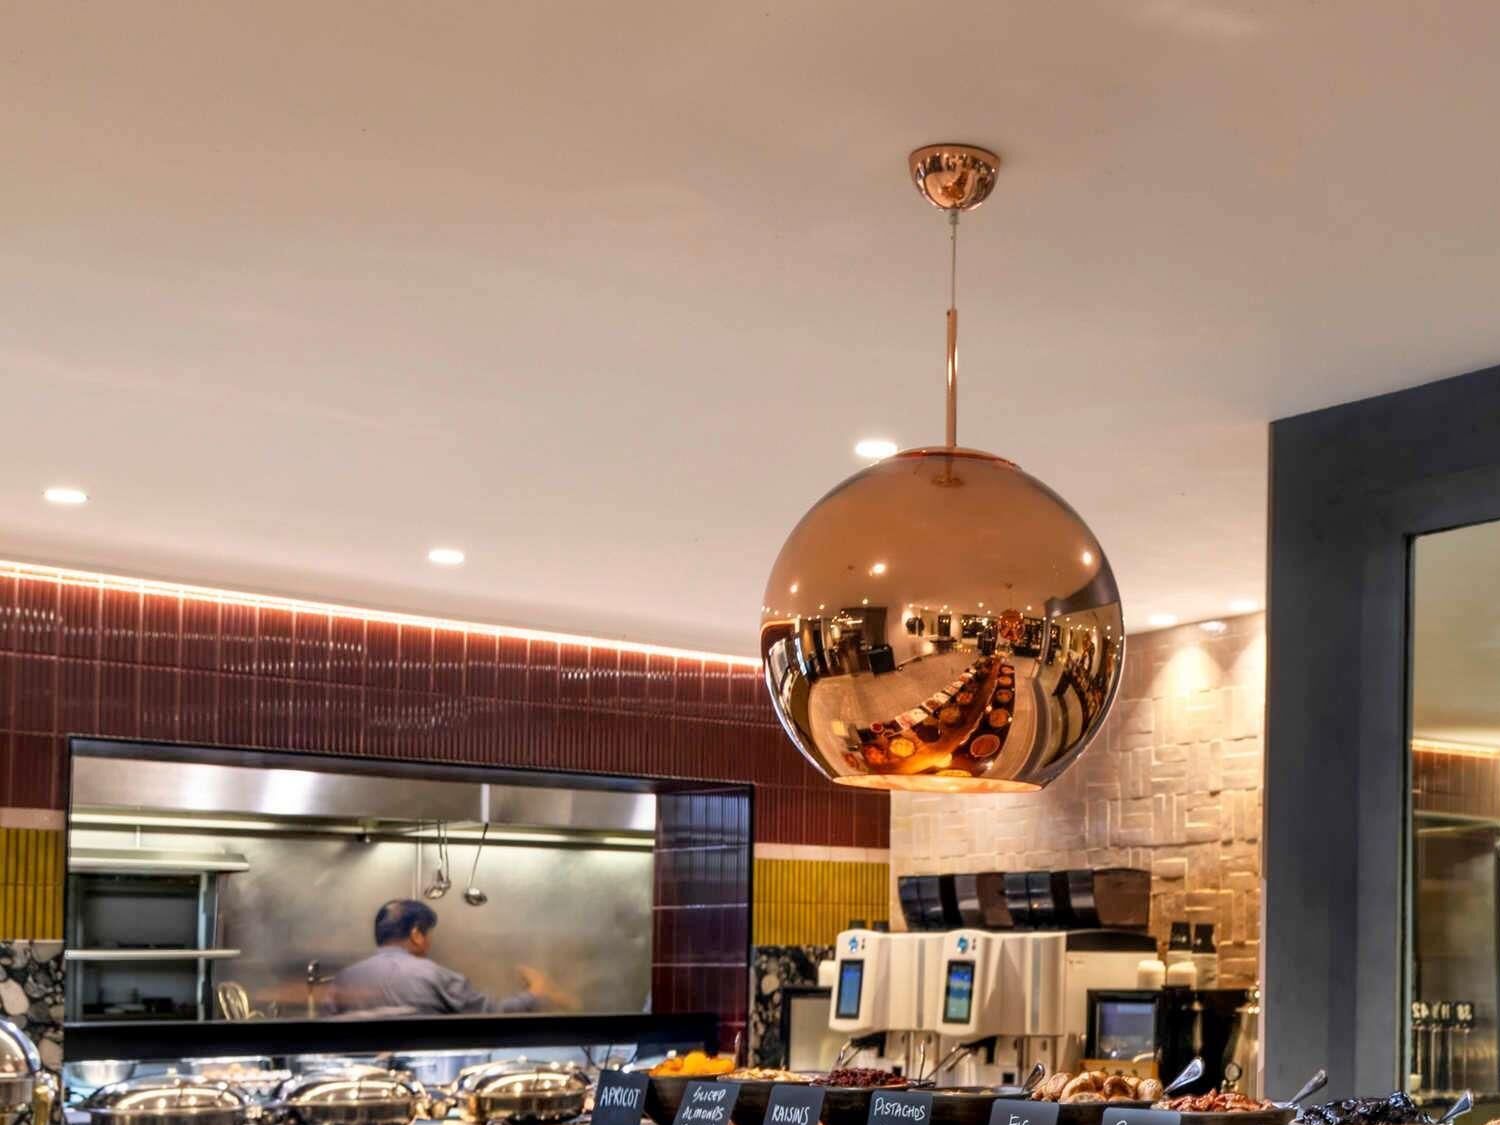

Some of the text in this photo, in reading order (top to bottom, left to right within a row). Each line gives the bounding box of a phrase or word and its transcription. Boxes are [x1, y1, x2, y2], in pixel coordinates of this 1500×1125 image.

[600, 1086, 641, 1109] APRICOT
[692, 1086, 726, 1103] SLICED
[682, 1105, 726, 1121] ALMONDS
[772, 1104, 810, 1125] RAISINS
